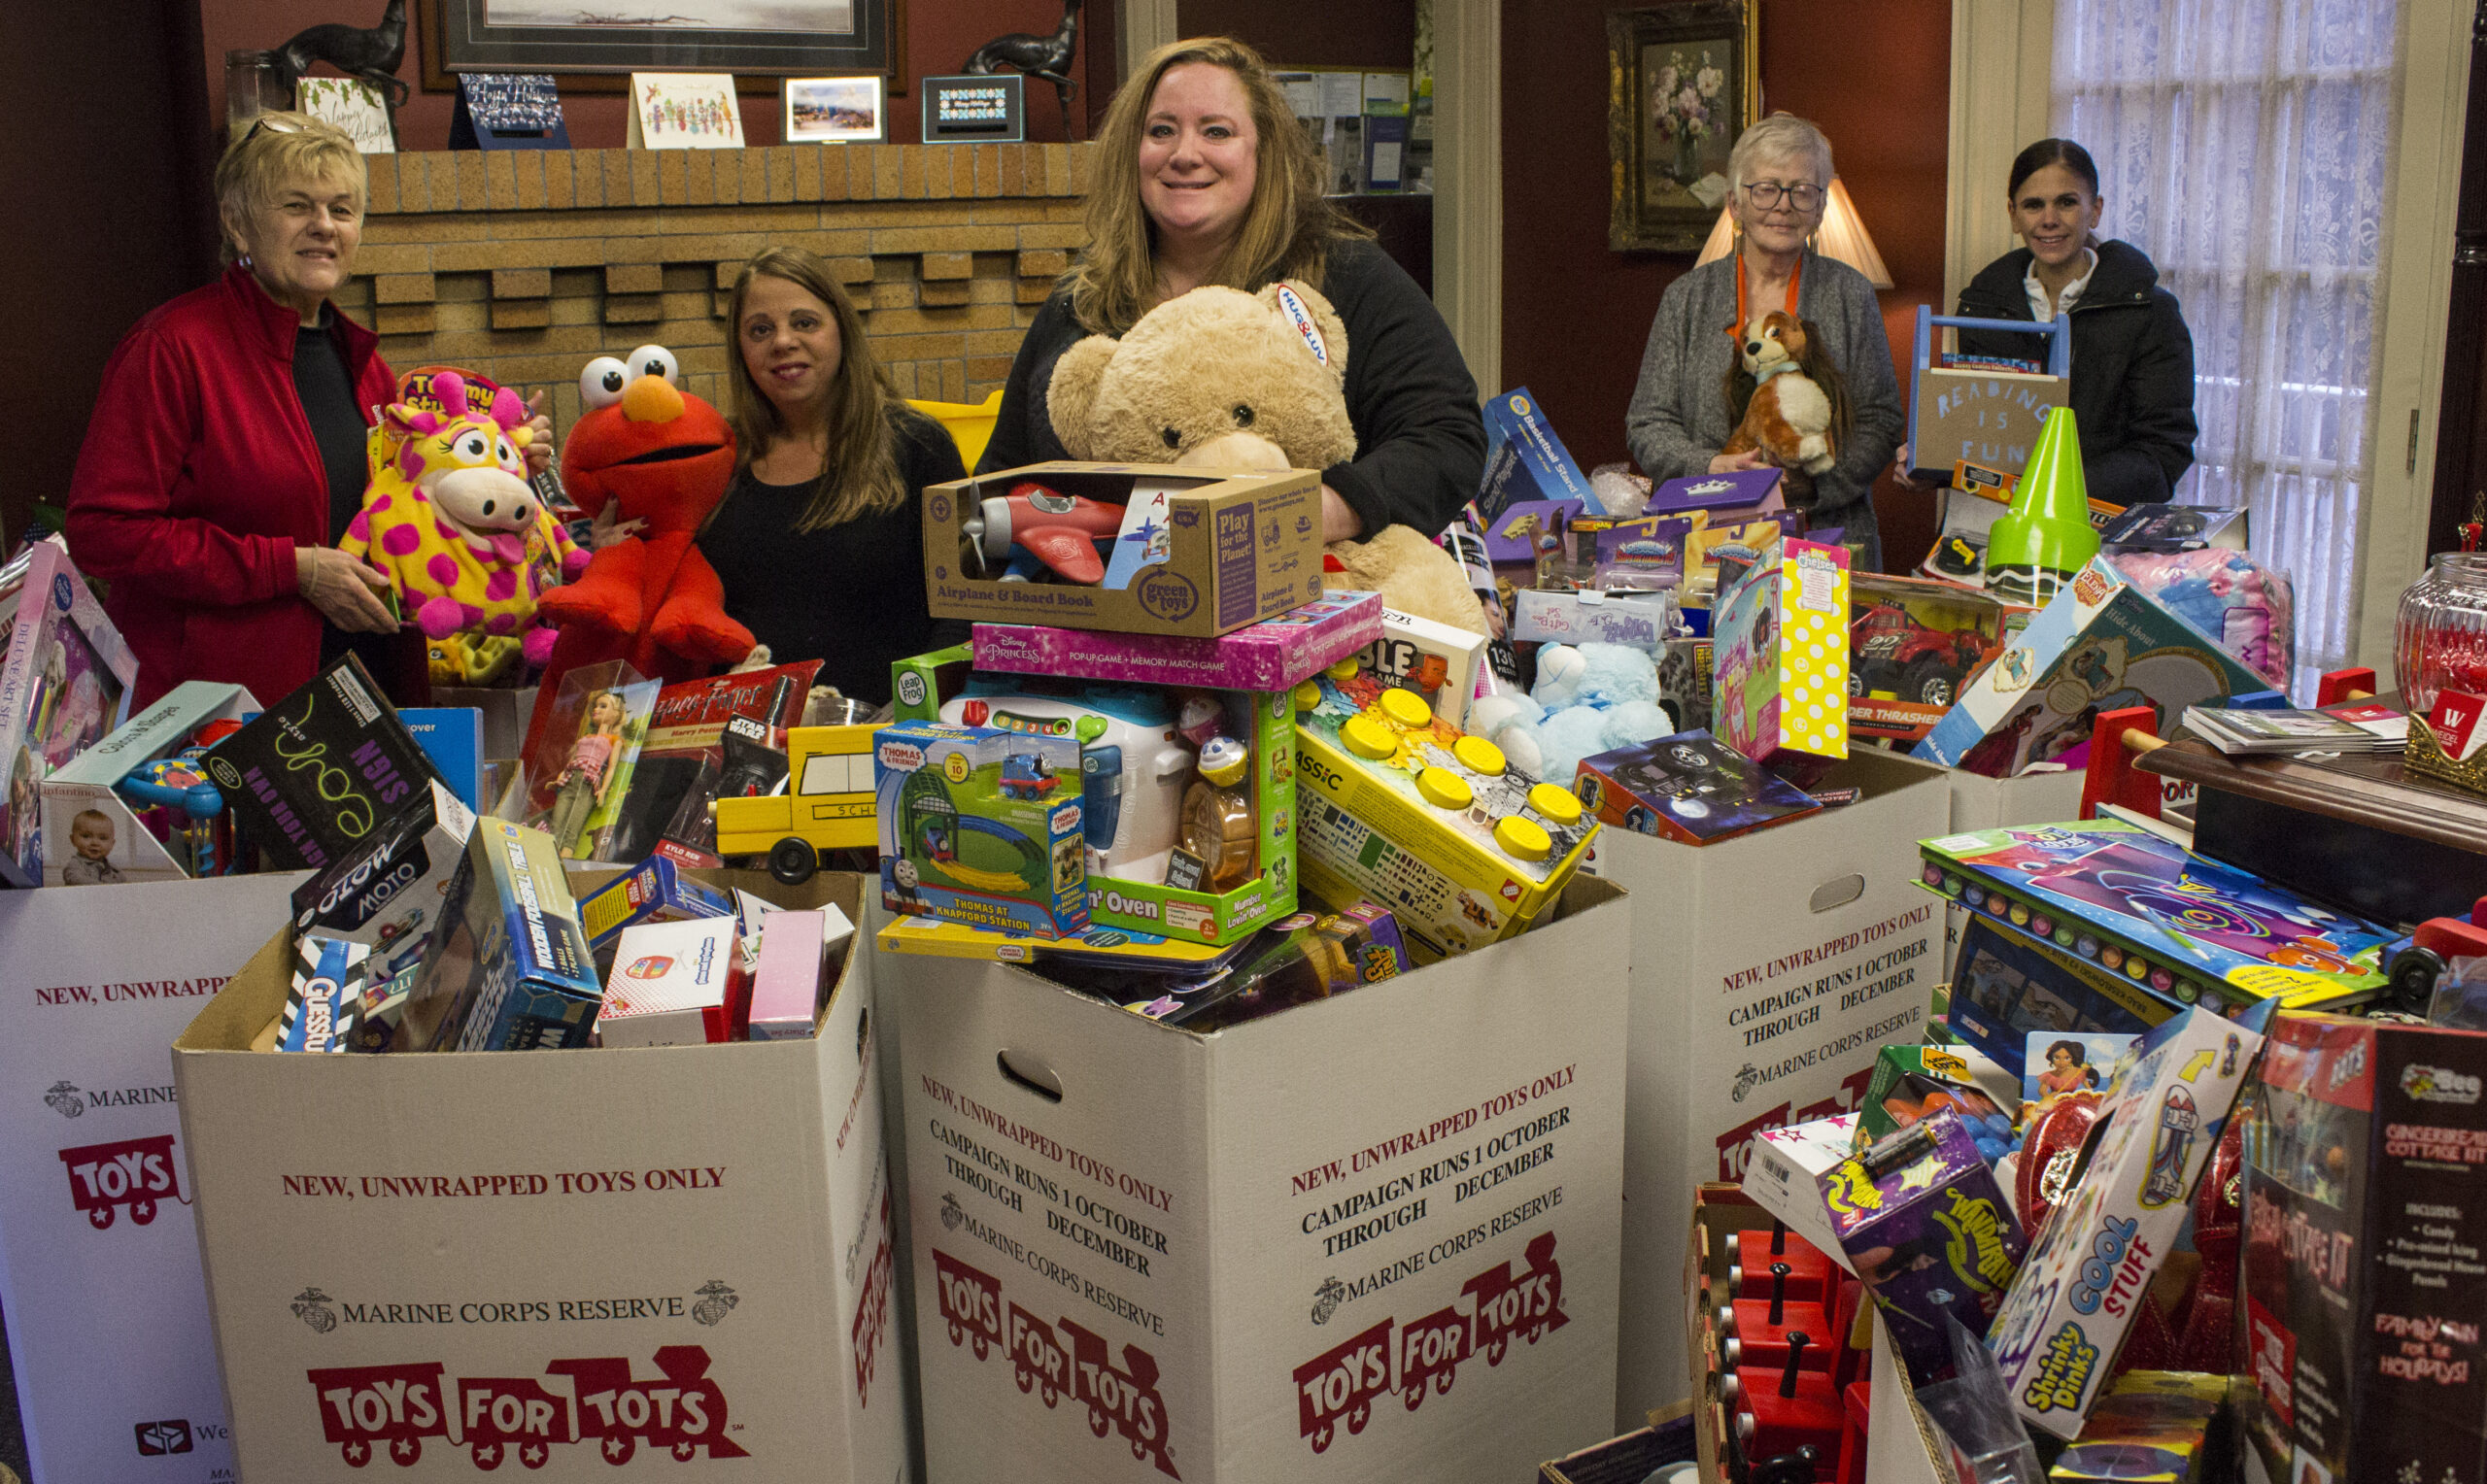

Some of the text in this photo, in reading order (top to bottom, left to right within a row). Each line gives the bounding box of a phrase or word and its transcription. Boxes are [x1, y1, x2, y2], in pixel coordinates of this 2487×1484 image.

[1979, 411, 2008, 429] IS
[1524, 415, 1558, 463] Basketball
[1555, 463, 1579, 493] Stand
[1961, 441, 2026, 463] FUN
[1219, 514, 1249, 534] Play
[1220, 533, 1249, 549] for the
[1220, 544, 1252, 563] Planet!
[1796, 556, 1839, 573] Chelsea
[937, 585, 1094, 608] Airplane & Board Book
[1146, 583, 1188, 604] green
[1160, 596, 1188, 613] toys
[1261, 586, 1287, 603] Airplane
[1261, 595, 1296, 615] Board Book
[2105, 608, 2156, 647] Hide About
[1000, 633, 1027, 649] Disney
[1865, 635, 1901, 651] 22
[986, 643, 1042, 664] PRINCESS
[1097, 653, 1124, 664] GAME
[1131, 656, 1168, 667] MEMORY
[1169, 658, 1199, 669] MATCH
[1199, 660, 1226, 671] GAME
[1489, 645, 1516, 668] 136
[1, 623, 29, 730] DELUXE ART SET
[1698, 648, 1707, 693] BRIGHT
[901, 676, 920, 691] Leap
[903, 687, 923, 701] Frog
[732, 718, 767, 732] STAR
[1876, 709, 1943, 725] THRASHER
[2444, 708, 2466, 727] W
[671, 728, 697, 738] Harry
[730, 725, 765, 740] WARS
[99, 736, 135, 755] Colors
[883, 747, 921, 761] THOMAS
[350, 739, 409, 804] SIGN
[892, 758, 918, 768] FRIENDS
[951, 766, 963, 776] 10
[43, 786, 100, 797] infantino
[1825, 789, 1854, 799] ROBOT
[243, 765, 308, 843] YOUR OWN
[1054, 810, 1079, 825] THOMAS
[664, 843, 685, 856] KYLO
[685, 850, 700, 860] REN
[358, 863, 416, 922] MOTO
[1061, 889, 1079, 900] THOMAS
[1062, 893, 1086, 909] KNAPFORD
[1234, 893, 1262, 913] Number
[507, 841, 556, 970] WOODEN FOOSBALL TABLE
[954, 898, 1008, 916] THOMAS AT
[1062, 903, 1081, 917] STATION
[1107, 892, 1159, 919] Oven
[1227, 902, 1267, 929] Lovin' Oven
[937, 906, 1030, 931] KNAPFORD STATION
[557, 946, 567, 967] BALLS
[562, 928, 578, 967] PLAYER GAME
[1722, 965, 1763, 994] NEW,
[1767, 932, 1859, 979] UNWRAPPED
[1862, 918, 1896, 946] TOYS
[1898, 902, 1933, 930] ONLY
[35, 975, 234, 1008] NEW, UNWRAPP
[1728, 938, 1928, 1027] CAMPAIGN RUNS 1 OCTOBER
[1743, 968, 1915, 1047] THROUGH DECEMBER
[1758, 1049, 1816, 1086] MARINE
[1820, 1030, 1863, 1062] CORPS
[1864, 1006, 1921, 1043] RESERVE
[88, 1085, 178, 1109] MARINE
[1290, 1065, 1578, 1196] NEW, UNWRAPPED TOYS ONLY
[921, 1074, 1175, 1213] NEW, UNWRAPPED TOYS ONLY
[74, 1150, 171, 1199] TOYS
[1302, 1106, 1572, 1234] CAMPAIGN RUNS 1 OCTOBER
[283, 1165, 726, 1201] NEW, UNWRAPPED TOYS ONLY
[929, 1119, 1010, 1175] CAMPAIGN
[1014, 1164, 1060, 1202] RUNS
[1063, 1186, 1071, 1207] 1
[1073, 1191, 1170, 1255] OCTOBER
[1323, 1142, 1555, 1257] THROUGH DECEMBER
[943, 1155, 1151, 1277] THROUGH DECEMBER
[1346, 1187, 1563, 1302] MARINE CORPS RESERVE
[963, 1215, 1165, 1337] MARINE CORPS RESERVE
[2070, 1215, 2139, 1316] COOL
[2103, 1235, 2153, 1318] STUFF
[343, 1297, 686, 1326] MARINE CORPS RESERVE
[940, 1266, 1001, 1337] TOYS
[1011, 1318, 1064, 1377] FOR
[1079, 1361, 1158, 1439] TOTS
[1302, 1270, 1554, 1419] TOYS FOR TOTS
[2026, 1324, 2081, 1413] Shrinky
[2053, 1342, 2097, 1410] Dinks
[325, 1377, 709, 1435] TOYS FOR TOTS
